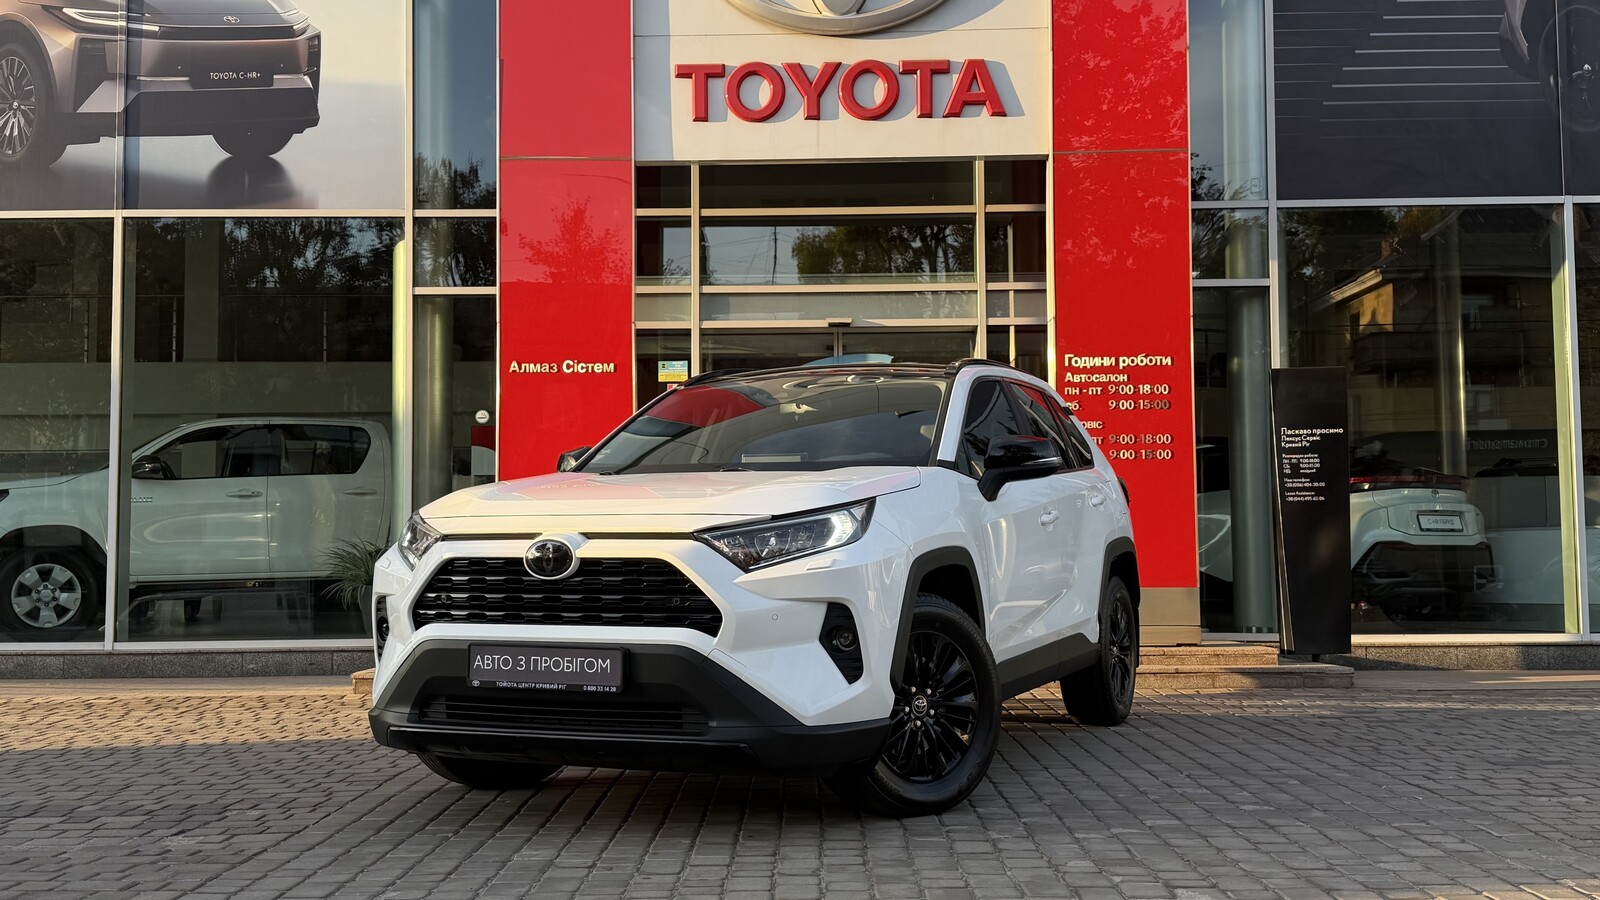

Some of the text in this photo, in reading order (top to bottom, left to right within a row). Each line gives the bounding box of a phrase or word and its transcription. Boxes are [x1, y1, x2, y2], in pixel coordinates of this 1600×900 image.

[209, 72, 237, 80] TOYOTA
[674, 58, 1008, 123] TOYOTA
[508, 359, 615, 374] Алмаз Сістем
[1064, 353, 1172, 369] Години роботи
[1064, 372, 1128, 383] Автосалон
[1064, 386, 1080, 395] пн
[1281, 427, 1312, 435] Ласкаво
[473, 654, 611, 673] АВТО З ПРОБІГОМ
[536, 682, 558, 690] КРИВИЙ
